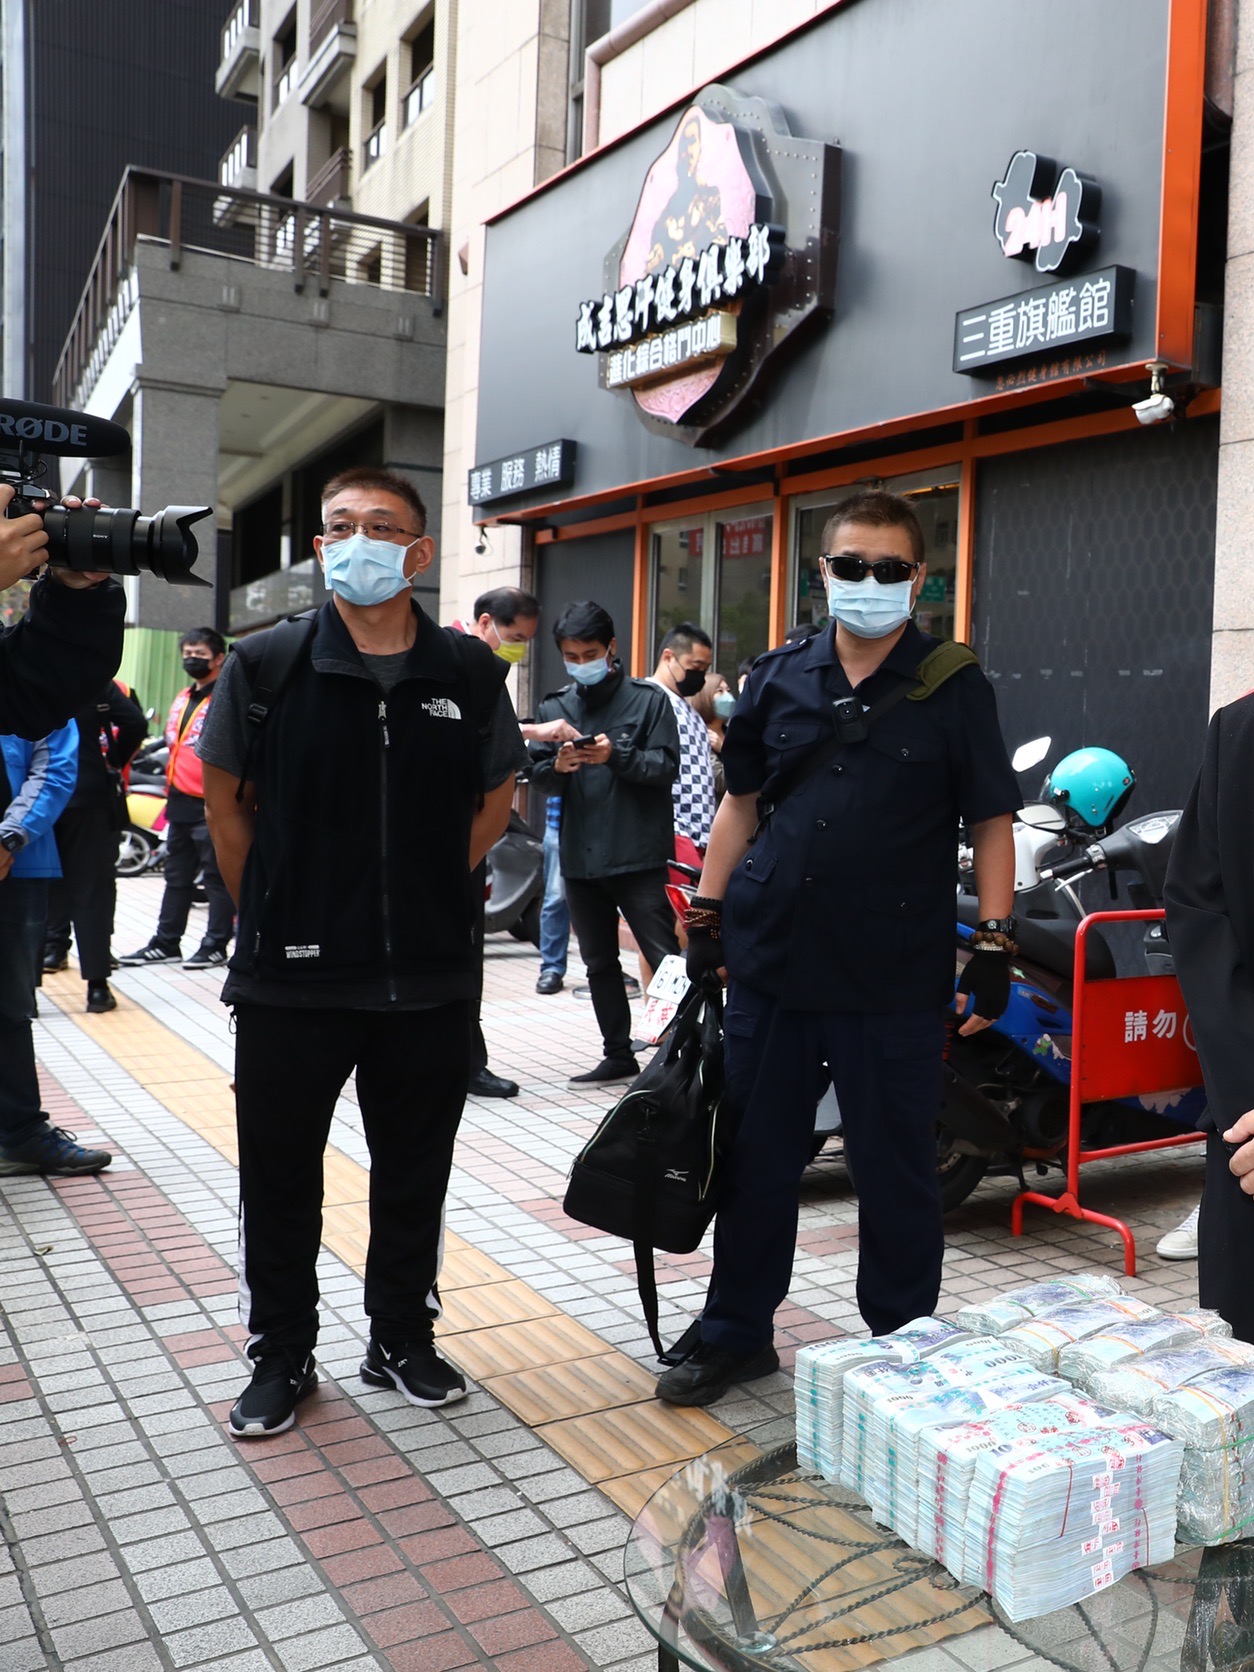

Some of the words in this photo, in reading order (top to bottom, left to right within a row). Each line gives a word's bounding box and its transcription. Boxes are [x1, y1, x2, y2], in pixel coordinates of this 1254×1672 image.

[1005, 191, 1067, 257] 24H
[960, 277, 1111, 361] 三重旗艦館
[470, 468, 492, 500] 專業
[501, 458, 525, 492] 服務
[534, 445, 561, 482] 熱情
[421, 703, 448, 711] NORTH
[430, 710, 448, 718] FACE
[1124, 1008, 1177, 1043] 請勿
[983, 1353, 1024, 1368] 1000
